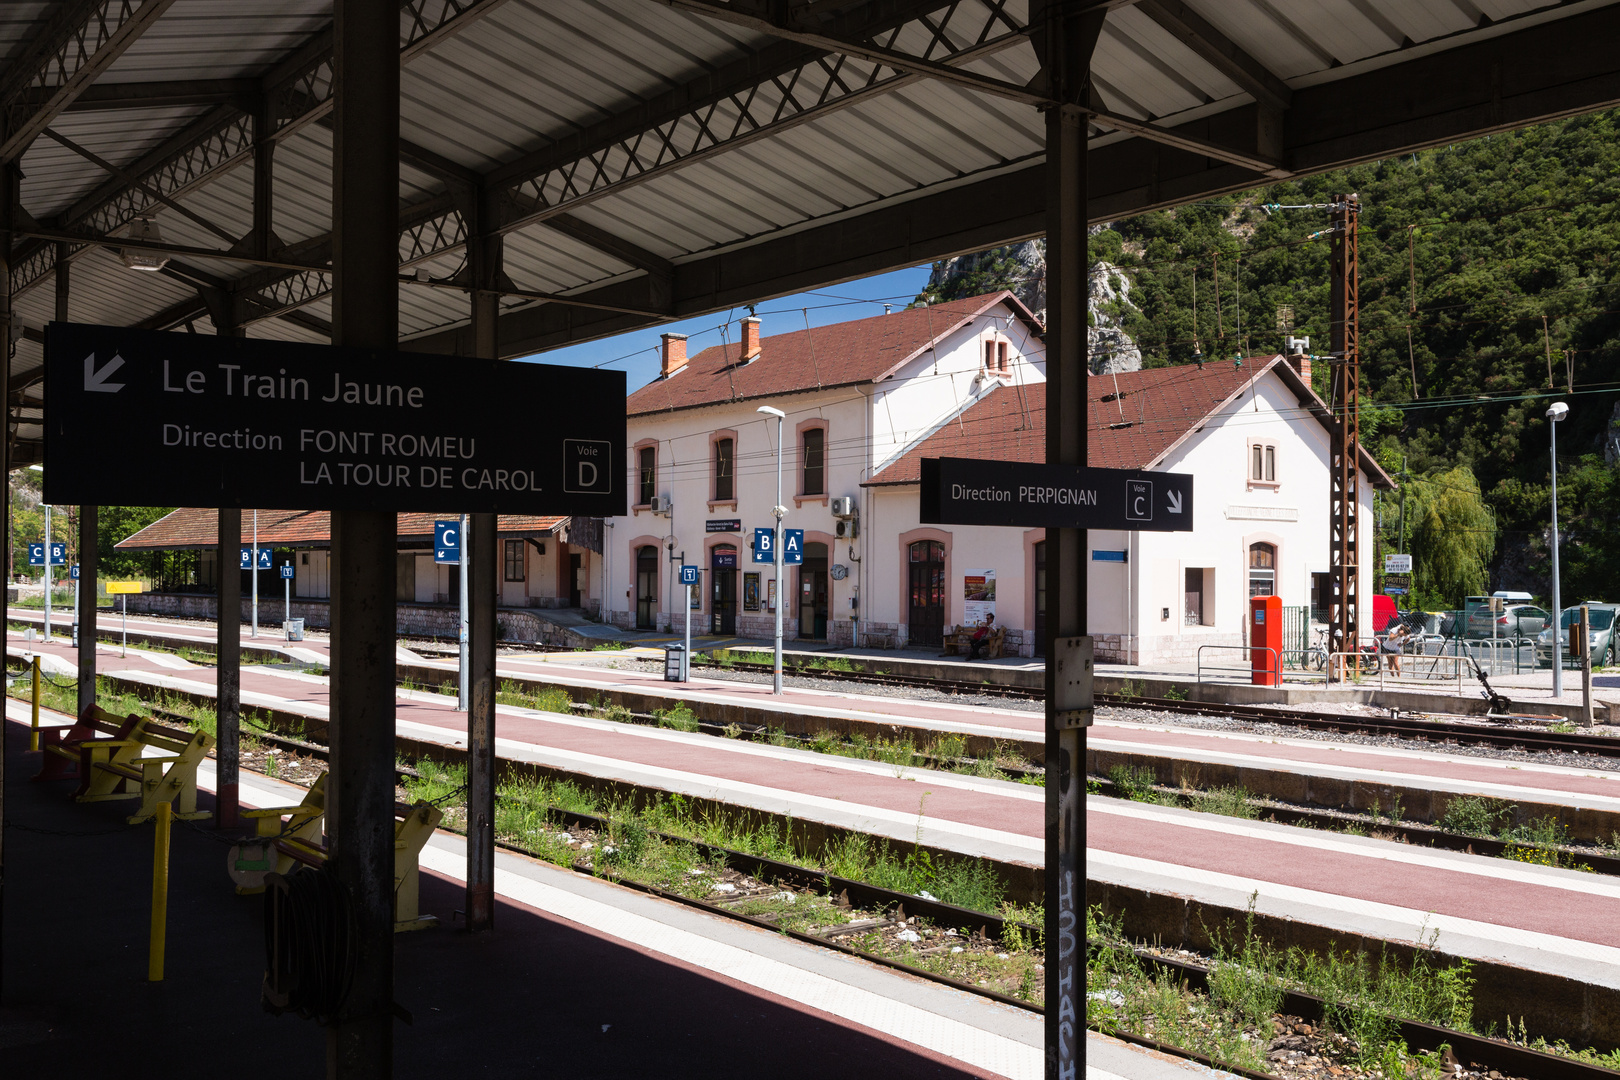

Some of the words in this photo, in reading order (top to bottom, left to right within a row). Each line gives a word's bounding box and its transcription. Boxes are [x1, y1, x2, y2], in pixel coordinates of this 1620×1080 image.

[163, 360, 206, 393] Le
[218, 364, 309, 400] Train
[321, 372, 424, 408] Jaune
[163, 424, 282, 451] Direction
[300, 429, 374, 455] FONT
[381, 433, 475, 460] ROMEU
[576, 445, 598, 456] Voie
[300, 461, 334, 485] LA
[337, 462, 411, 489] TOUR
[420, 466, 453, 490] DE
[460, 468, 542, 492] CAROL
[578, 461, 597, 487] D
[951, 484, 1011, 502] Direction
[1018, 486, 1097, 506] PERPIGNAN
[1133, 484, 1145, 493] Voie
[1134, 496, 1145, 516] C
[442, 529, 456, 547] C
[761, 535, 771, 550] B
[787, 536, 798, 551] A
[33, 547, 42, 557] C
[53, 547, 61, 557] B
[242, 552, 250, 561] B
[260, 552, 269, 561] A
